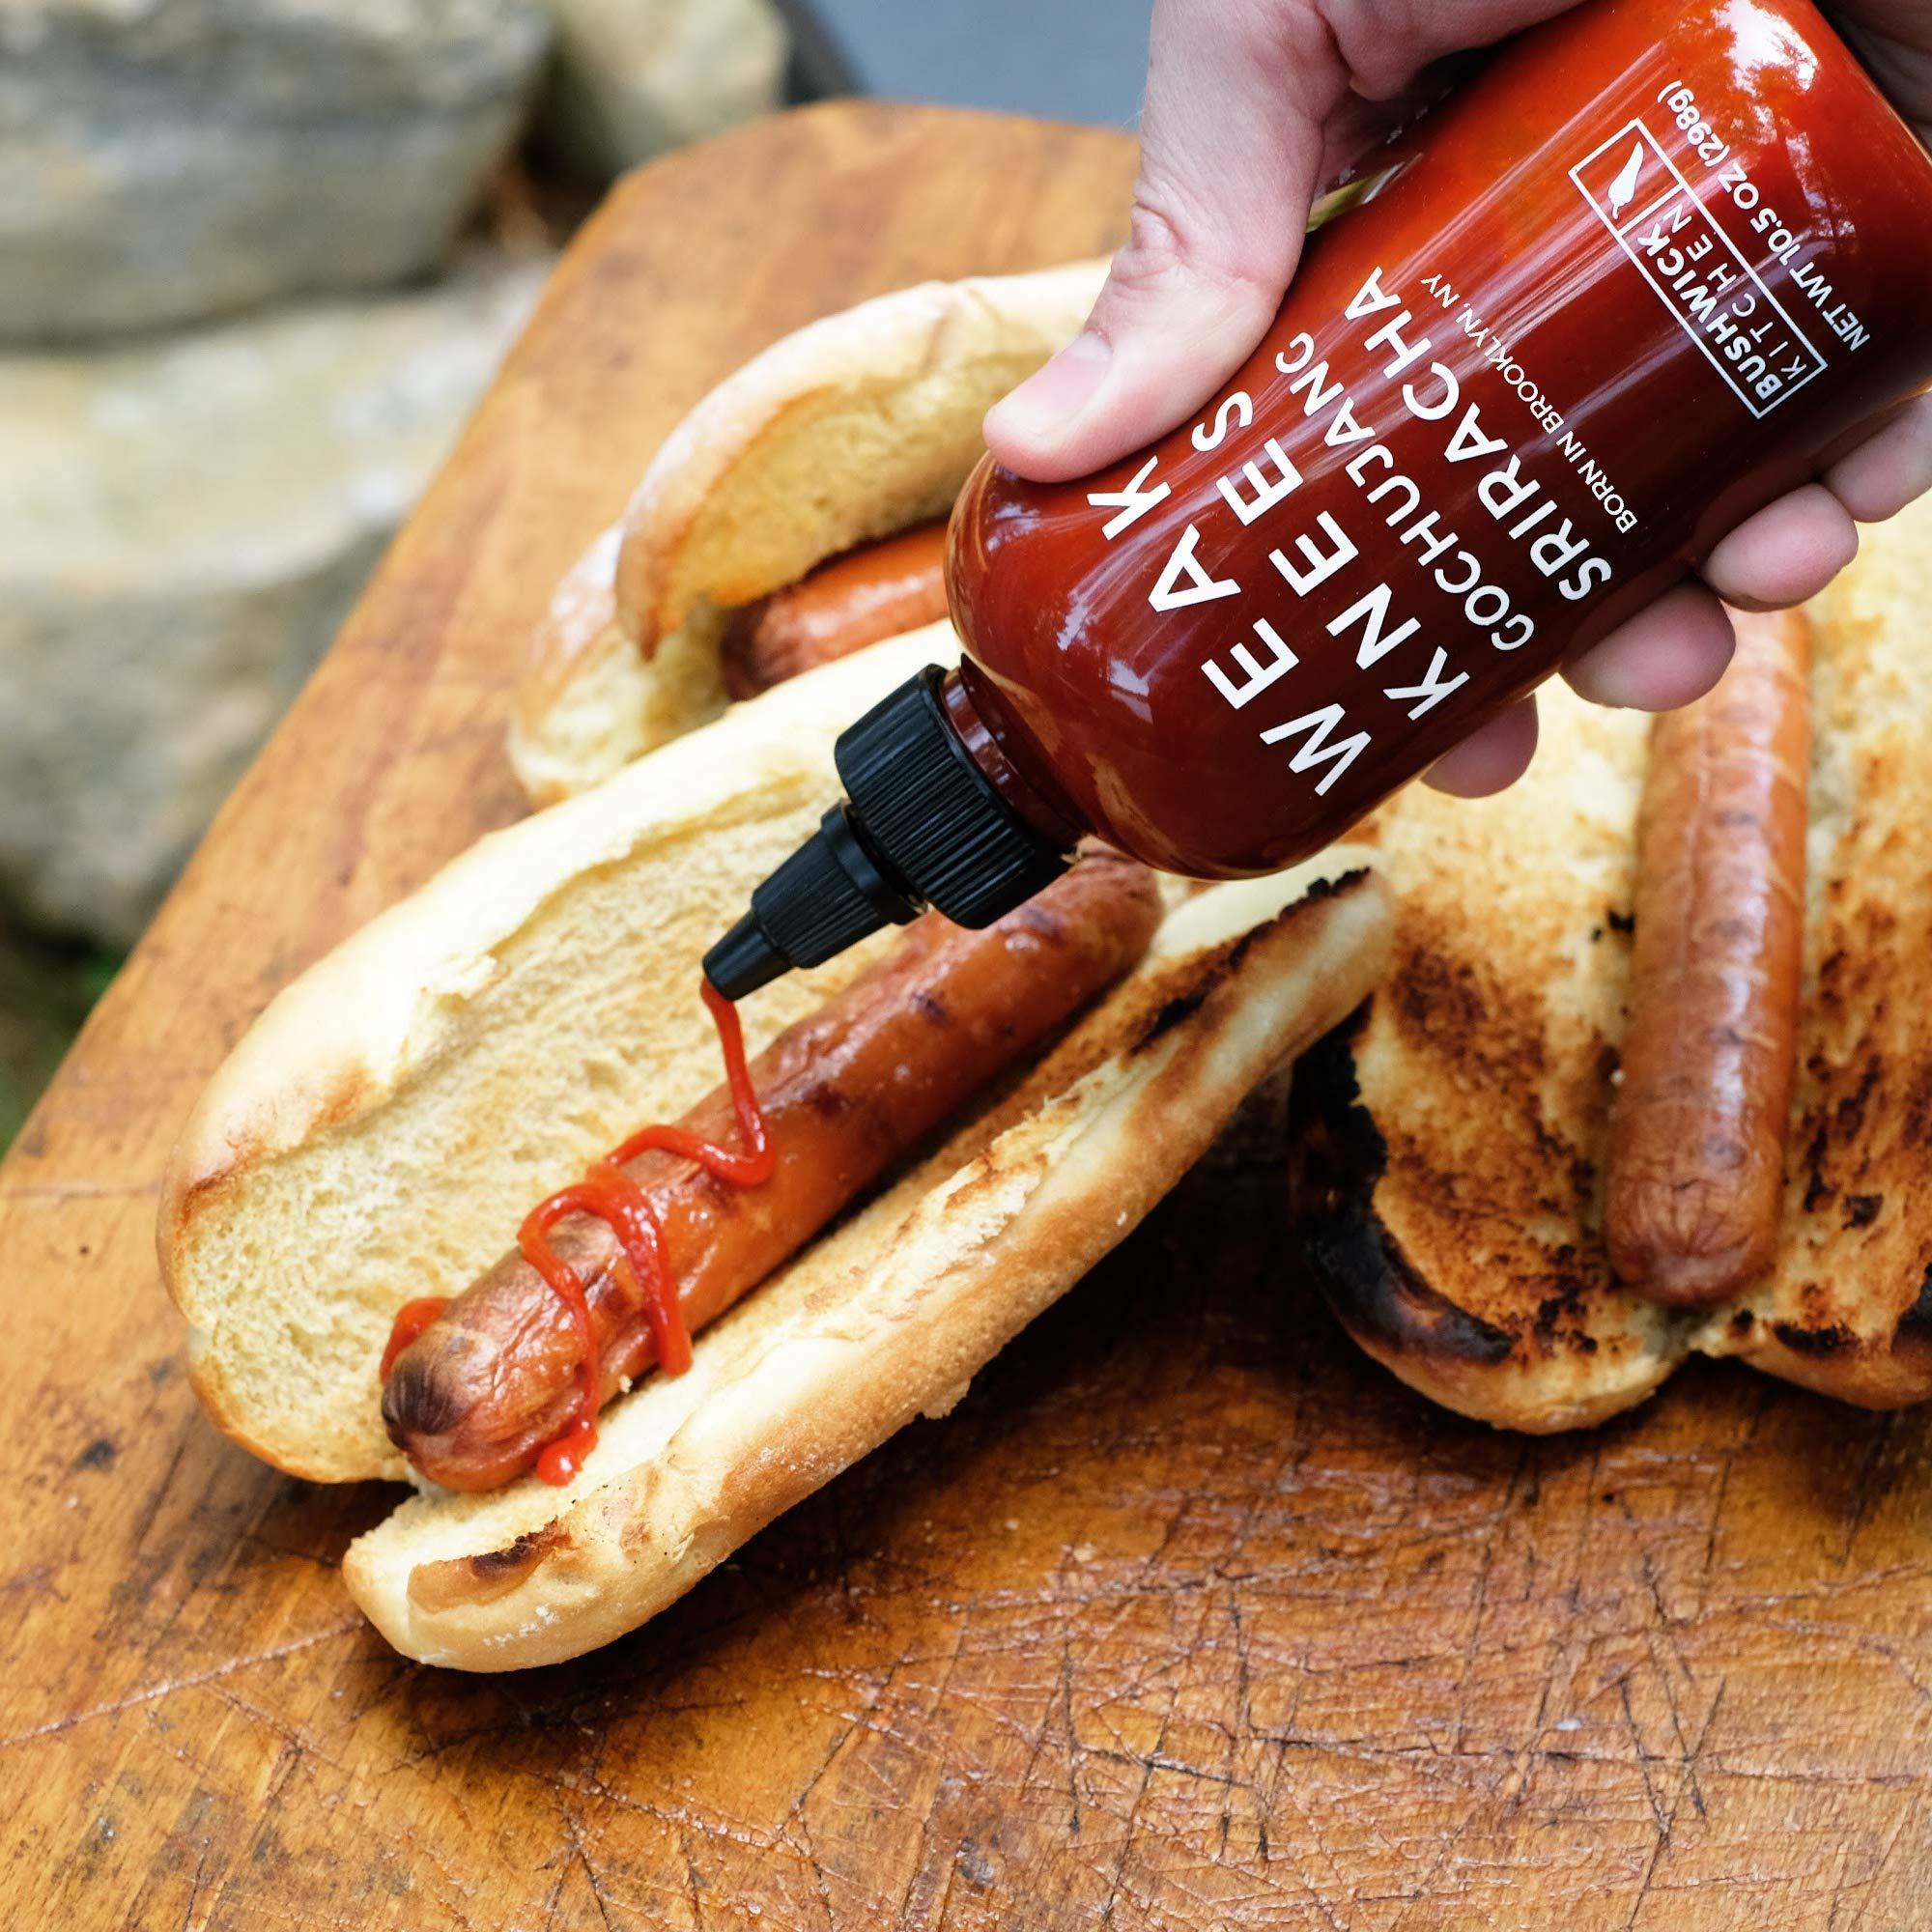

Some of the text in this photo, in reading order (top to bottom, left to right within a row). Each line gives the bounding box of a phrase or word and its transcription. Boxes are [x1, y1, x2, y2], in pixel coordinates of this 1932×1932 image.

[1636, 222, 1783, 401] BUSHWICK
[1657, 80, 1871, 352] NET WT 10.5 OZ (298g)
[1661, 203, 1807, 380] KITCHEN
[1275, 331, 1534, 651] GOCHUJANG
[1344, 266, 1612, 601] SRIRACHA
[1420, 273, 1638, 533] BORN IN BROOKLYN, NY
[1086, 455, 1372, 796] WEAK
[1190, 390, 1470, 721] KNEES
